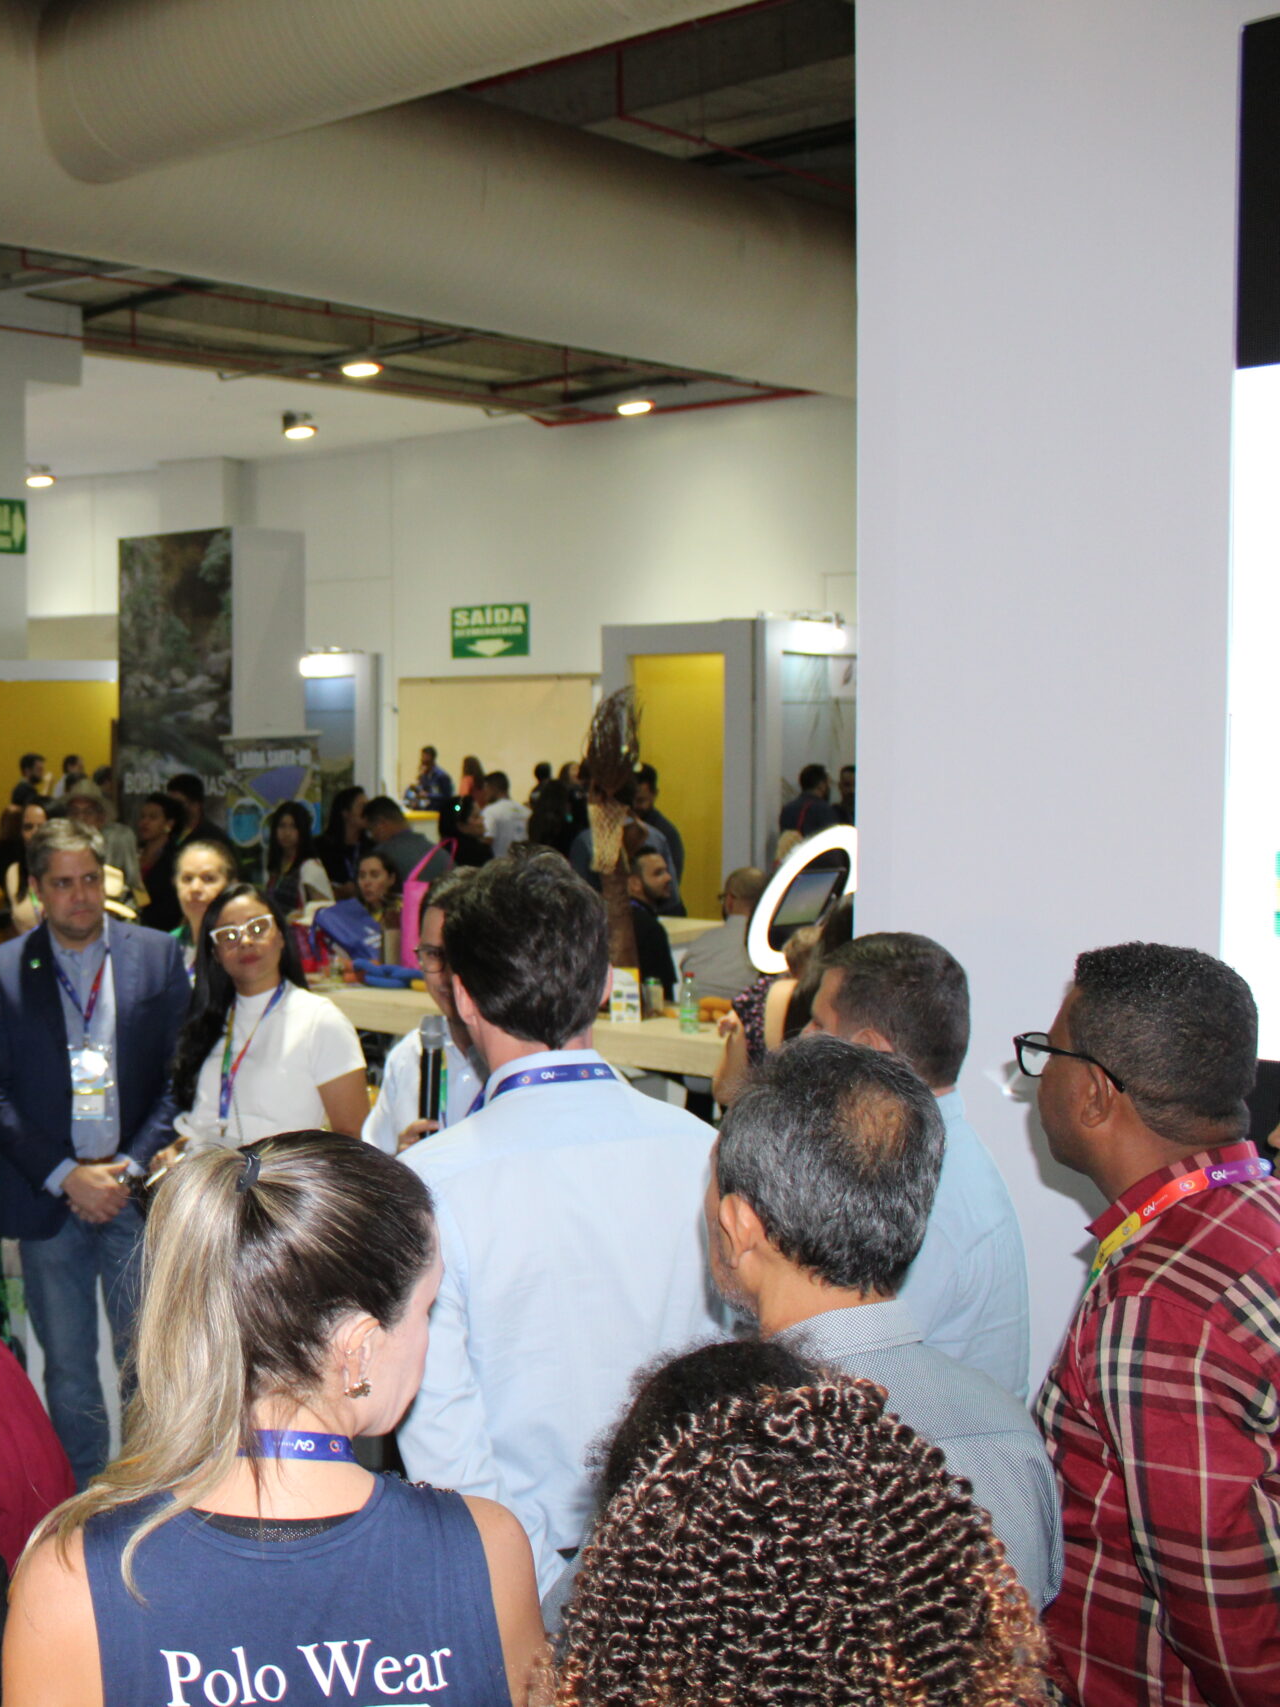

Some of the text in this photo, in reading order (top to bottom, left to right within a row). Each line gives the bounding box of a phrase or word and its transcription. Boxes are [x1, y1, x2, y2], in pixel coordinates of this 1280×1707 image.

[454, 604, 527, 626] SAÍDA
[160, 1638, 452, 1707] Polo Wear
